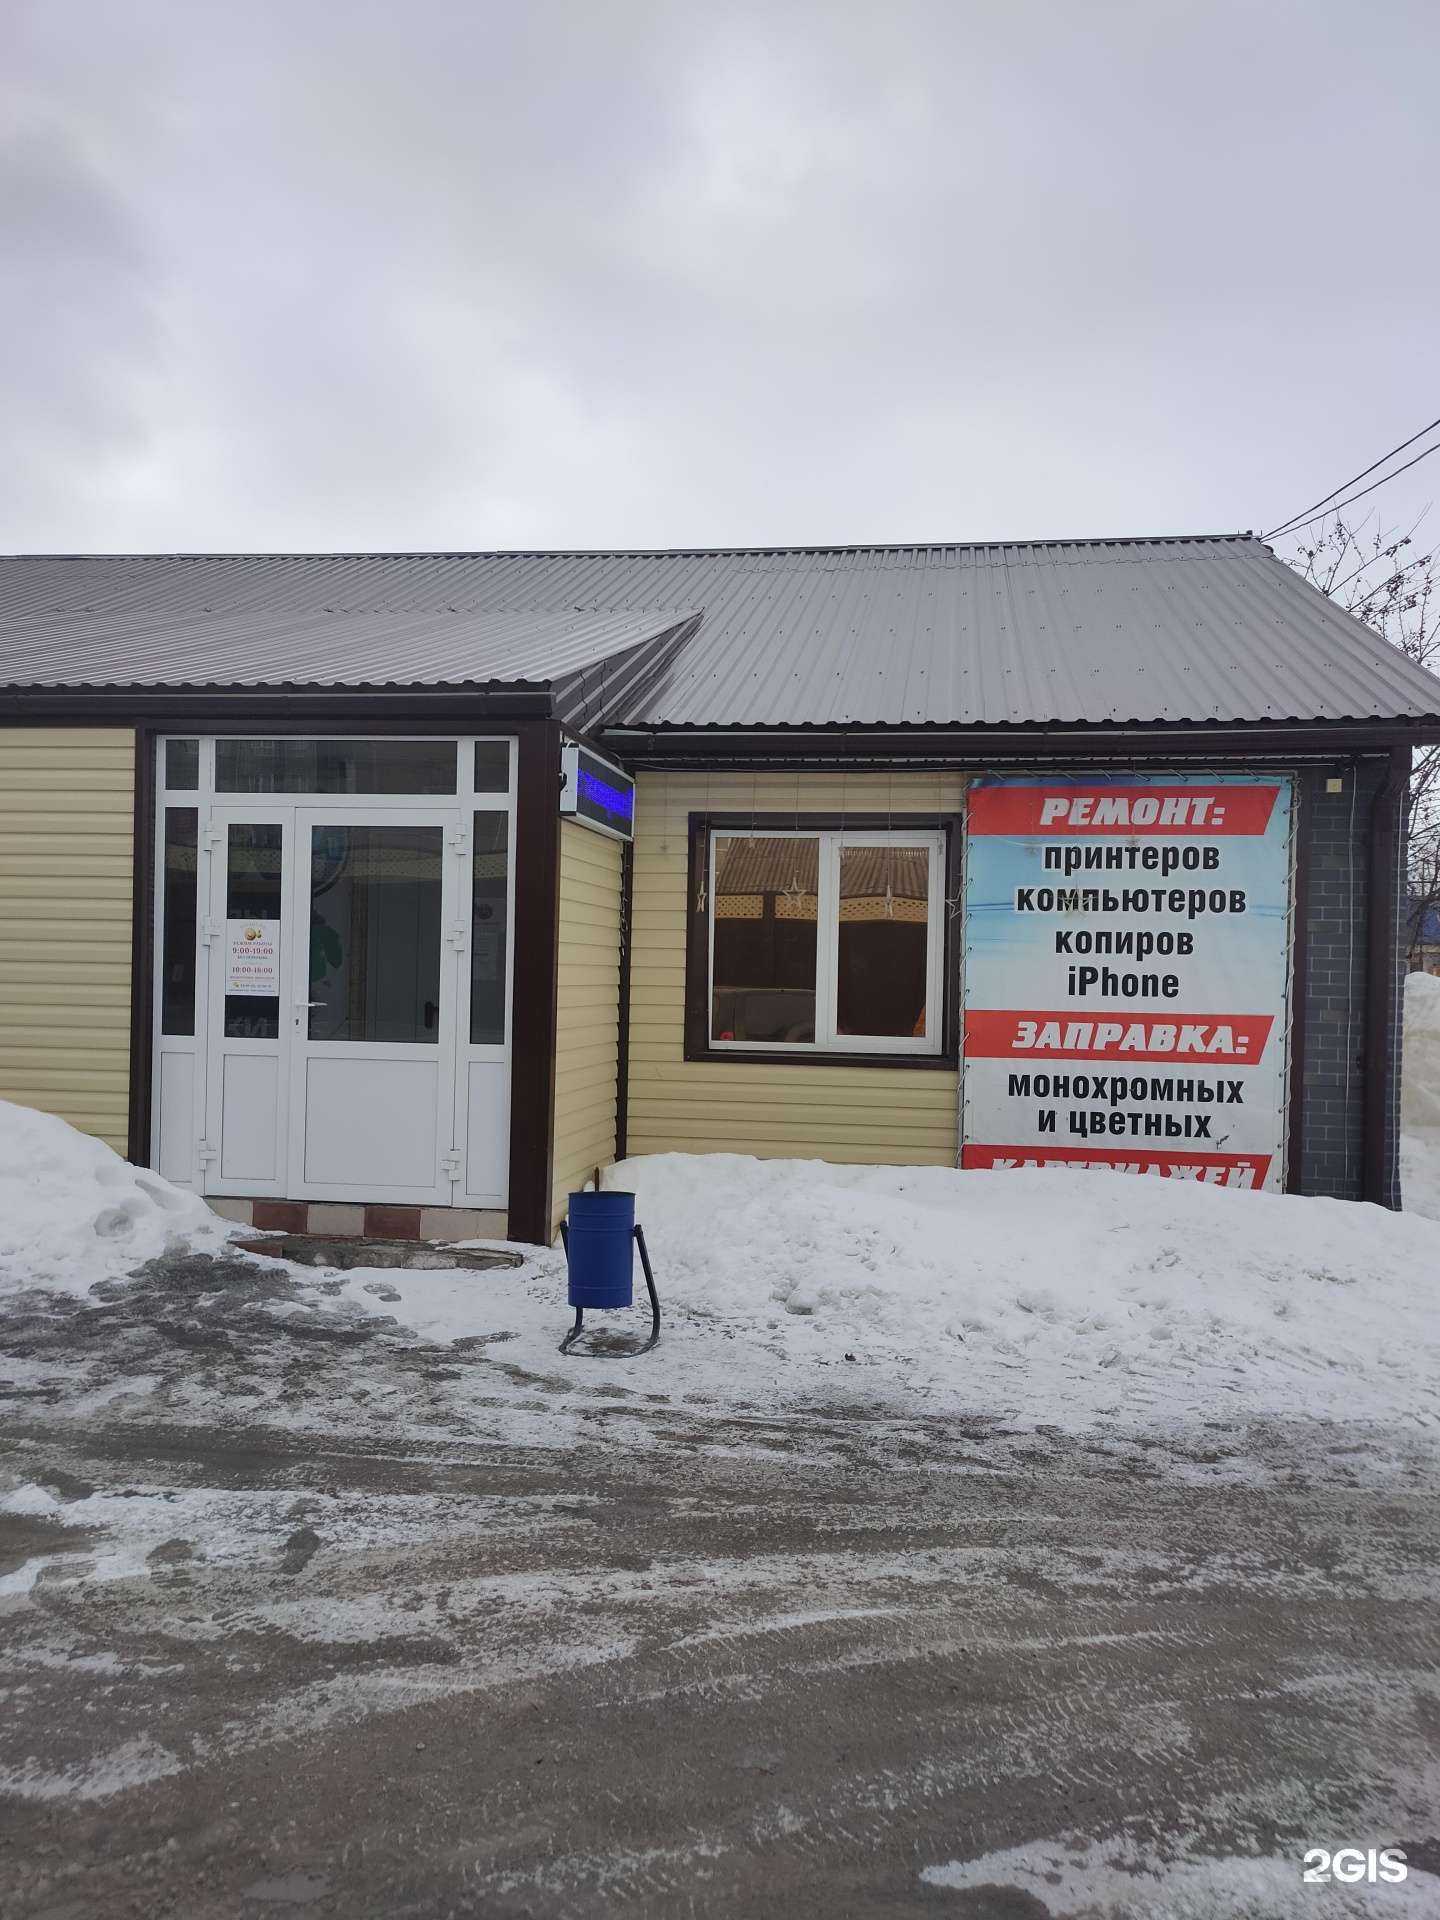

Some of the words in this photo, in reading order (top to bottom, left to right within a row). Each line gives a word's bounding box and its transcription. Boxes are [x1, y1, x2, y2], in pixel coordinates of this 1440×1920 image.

[1040, 796, 1226, 826] РЕМОНТ:
[1044, 845, 1221, 876] принтеров
[1016, 886, 1247, 919] компьютеров
[1055, 929, 1194, 962] копиров
[1068, 966, 1180, 998] iPhone
[1012, 1020, 1250, 1054] ЗАПРАВКА:
[1008, 1072, 1245, 1106] монохромных
[1037, 1109, 1056, 1133] и
[1069, 1110, 1213, 1139] цветных
